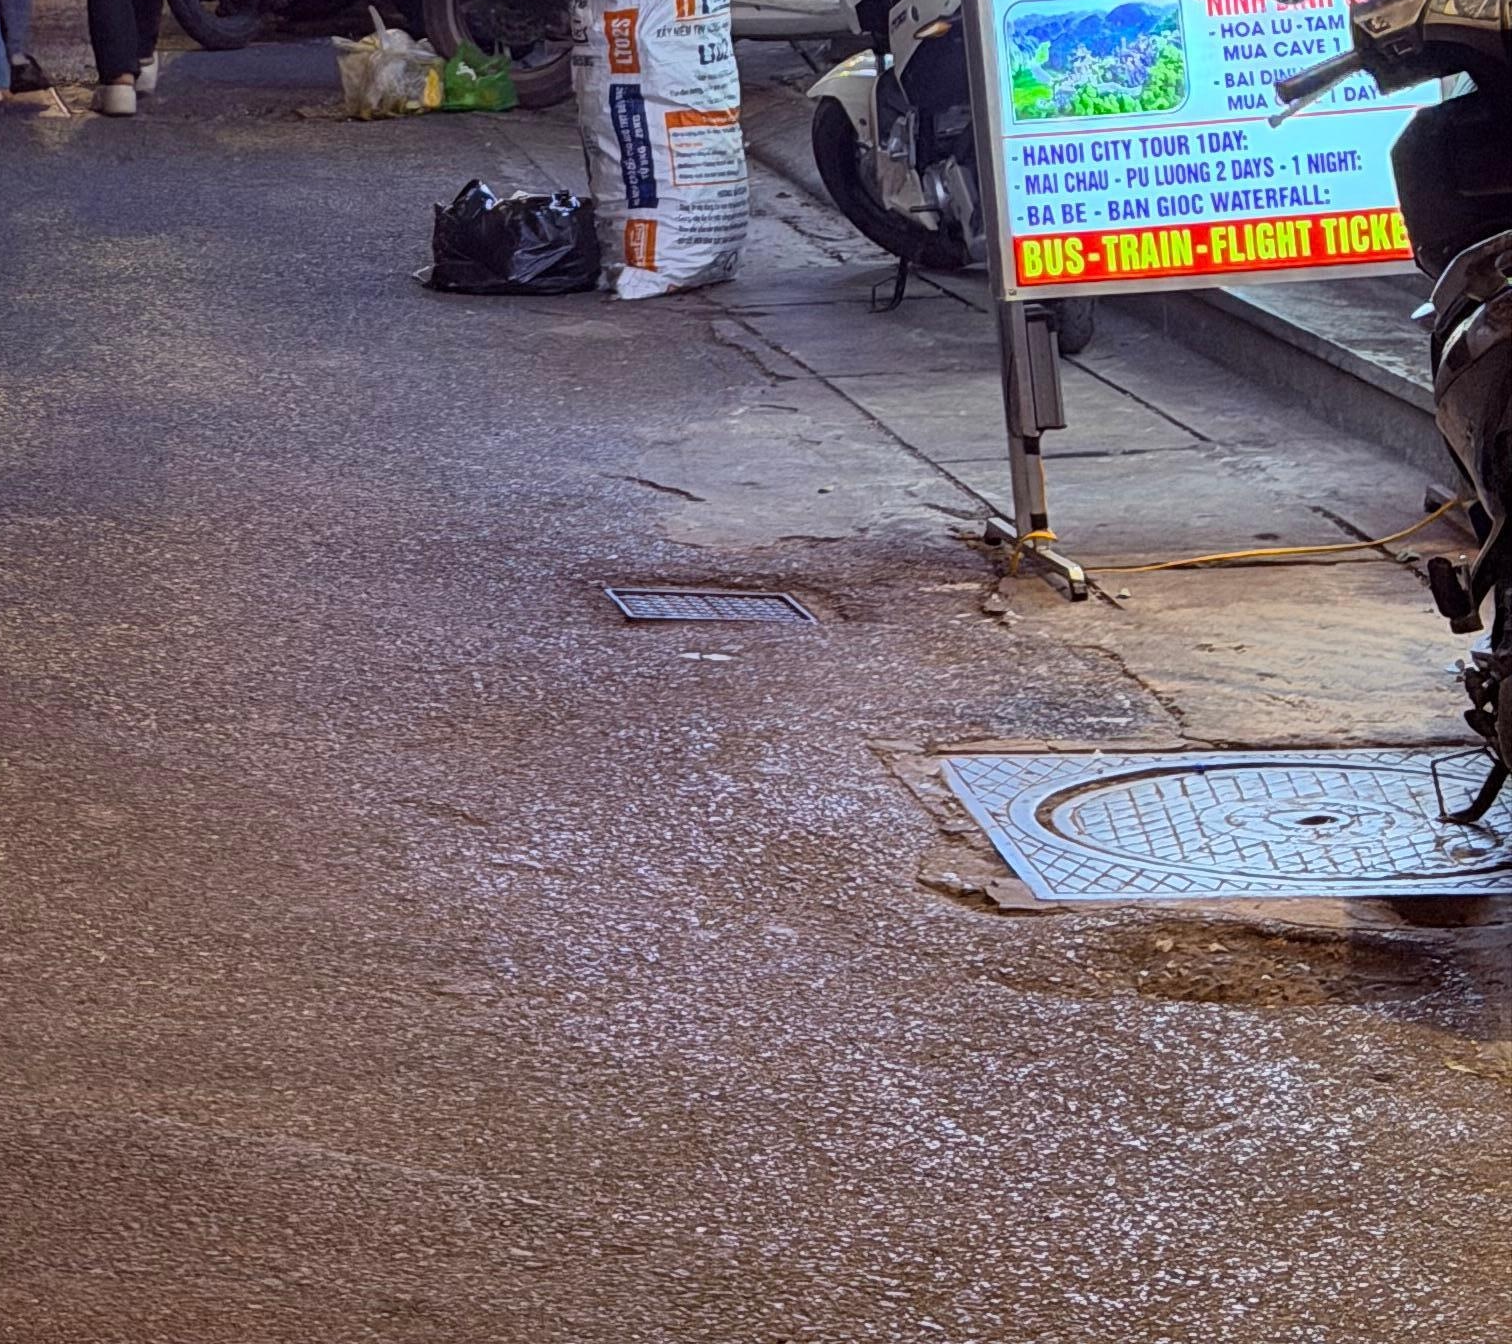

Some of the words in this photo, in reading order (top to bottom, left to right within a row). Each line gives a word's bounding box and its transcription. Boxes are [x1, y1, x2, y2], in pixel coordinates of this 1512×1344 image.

[1221, 21, 1265, 39] HOA
[1223, 43, 1267, 61] MUA
[1273, 38, 1326, 57] CAVE
[1225, 70, 1254, 88] BAI
[1227, 92, 1268, 111] MUA
[1022, 142, 1085, 167] HANOI
[1091, 138, 1131, 162] CITY
[1139, 135, 1188, 159] TOUR
[1025, 173, 1059, 195] MAI
[1065, 170, 1109, 193] CHAU
[1127, 167, 1149, 189] PU
[1154, 163, 1210, 186] LUONG
[1216, 161, 1226, 182] 2
[1232, 156, 1274, 180] DAYS
[1292, 154, 1300, 175] 1
[1307, 150, 1362, 174] NIGHT:
[1028, 204, 1055, 227] BA
[1062, 202, 1087, 224] BE
[1109, 197, 1150, 221] BAN
[1157, 193, 1204, 217] GIOC
[1210, 184, 1330, 212] WATERFALL:
